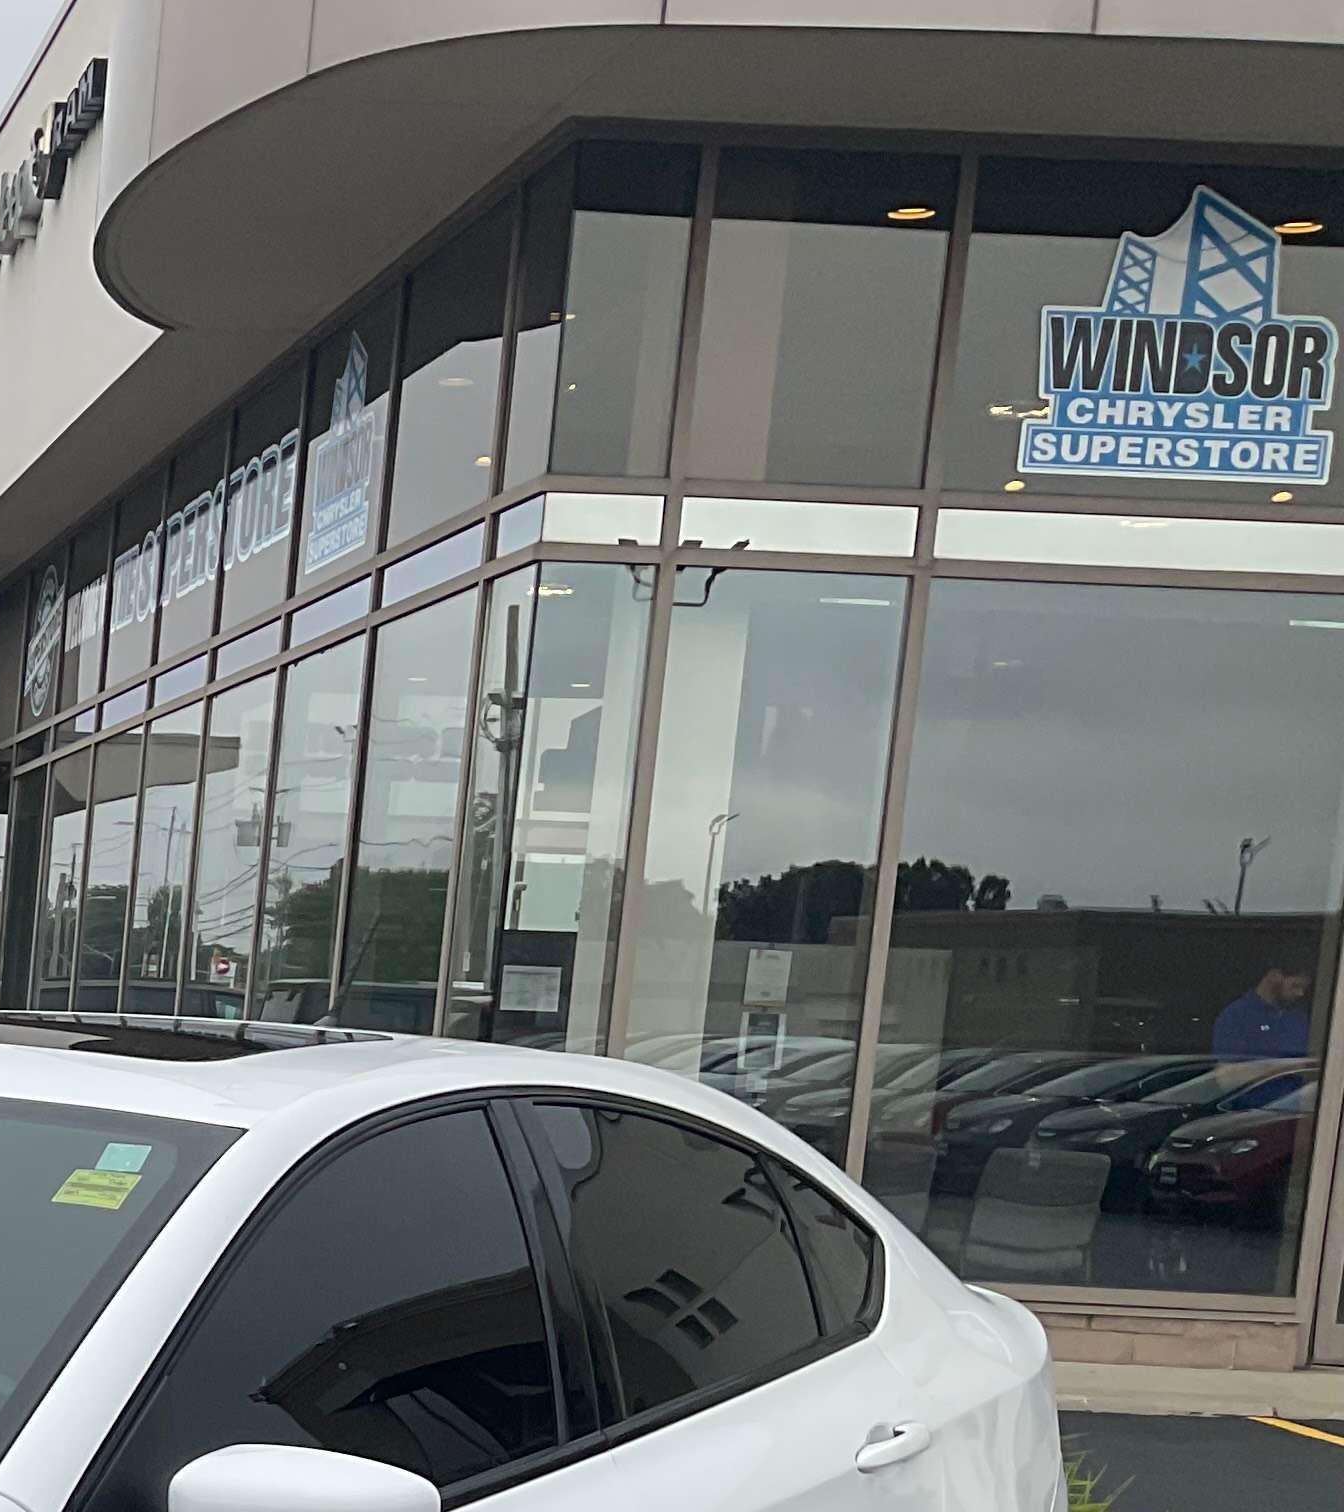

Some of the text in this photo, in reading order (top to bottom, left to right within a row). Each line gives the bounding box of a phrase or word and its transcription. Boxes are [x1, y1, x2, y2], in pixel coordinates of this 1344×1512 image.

[1050, 316, 1328, 400] WINDSOR
[1066, 397, 1293, 432] CHRYSLER
[1032, 432, 1319, 472] SUPERSTORE
